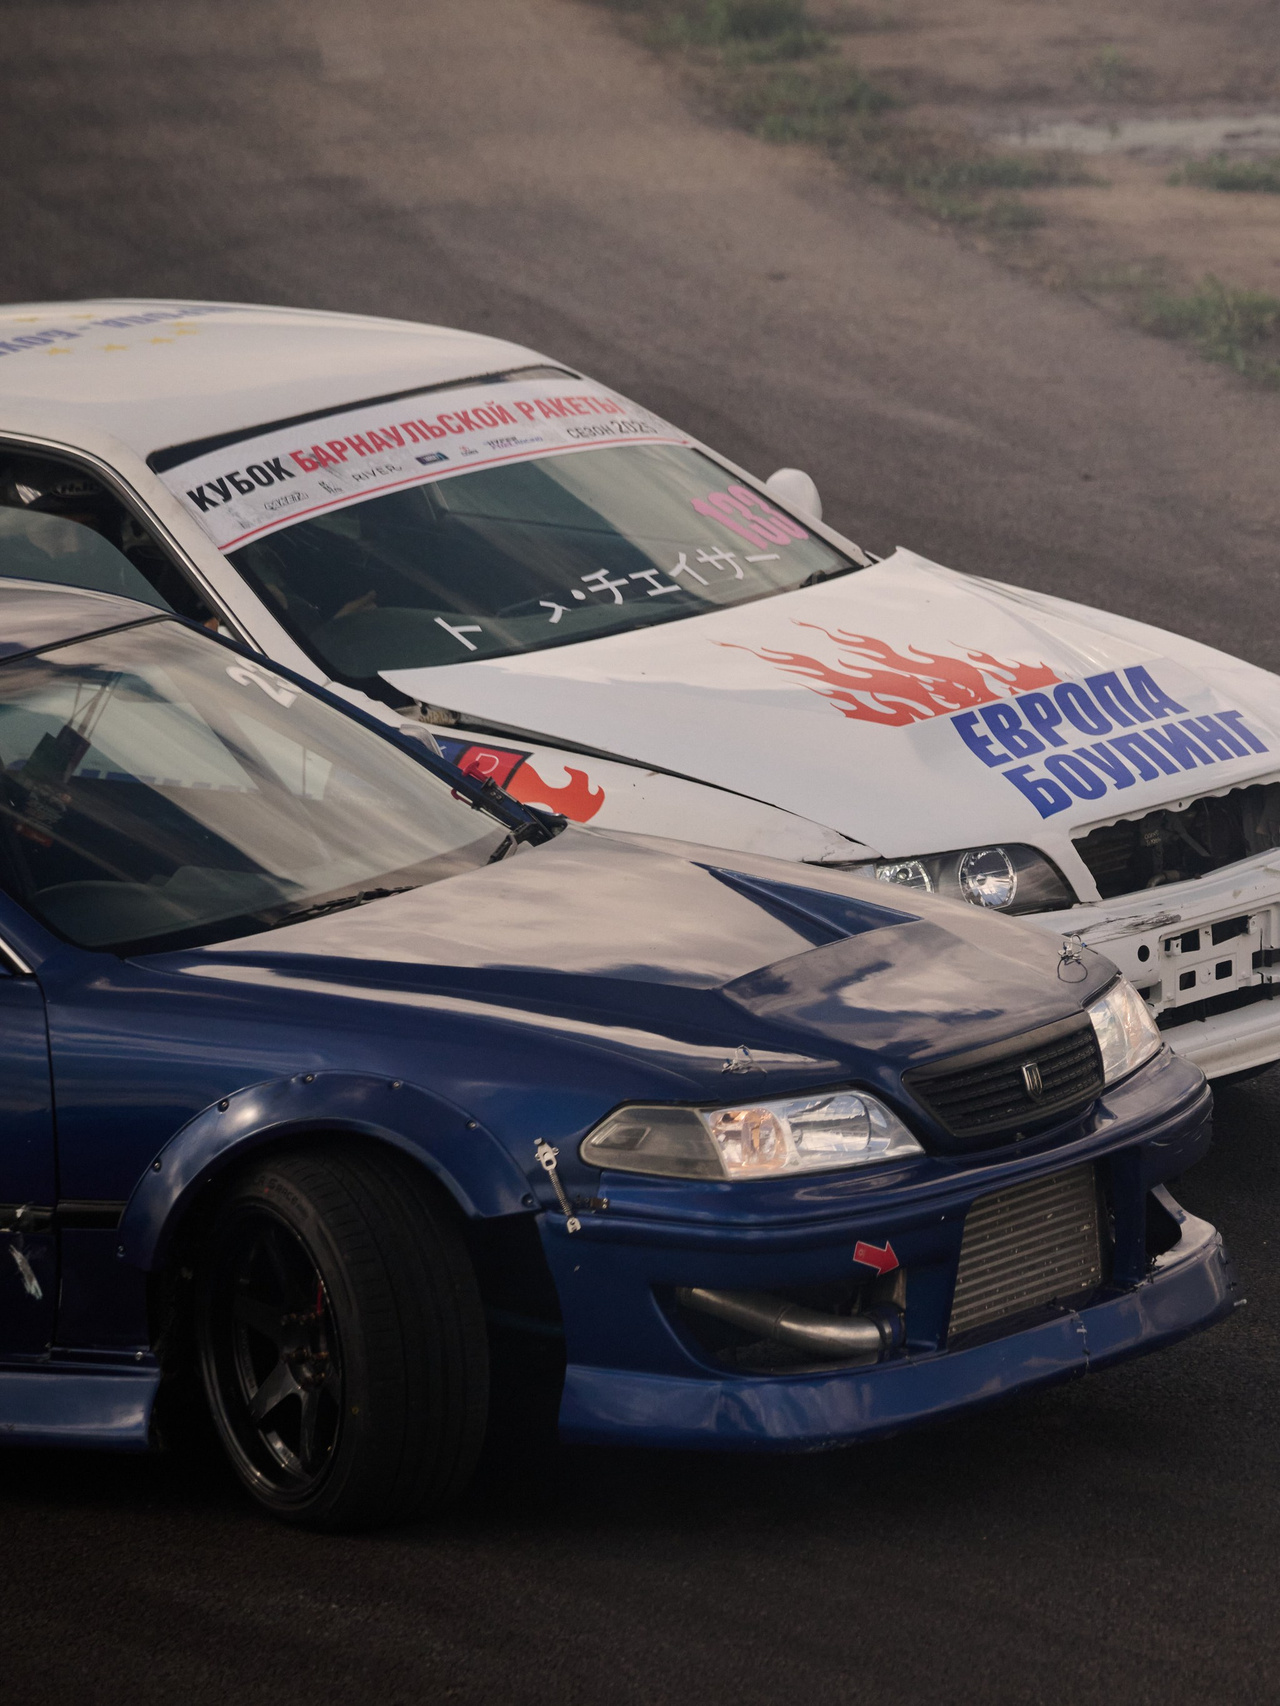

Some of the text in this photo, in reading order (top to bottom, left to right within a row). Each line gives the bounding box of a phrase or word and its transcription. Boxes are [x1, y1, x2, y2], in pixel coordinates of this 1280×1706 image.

[186, 397, 626, 512] КУБОК БАРНАУЛЬСКОЙ РАКЕТЫ
[566, 424, 615, 439] СЕЗОН
[690, 485, 809, 550] 133
[949, 665, 1189, 768] ЕВРОПА
[1001, 710, 1270, 820] БОУЛИНГ
